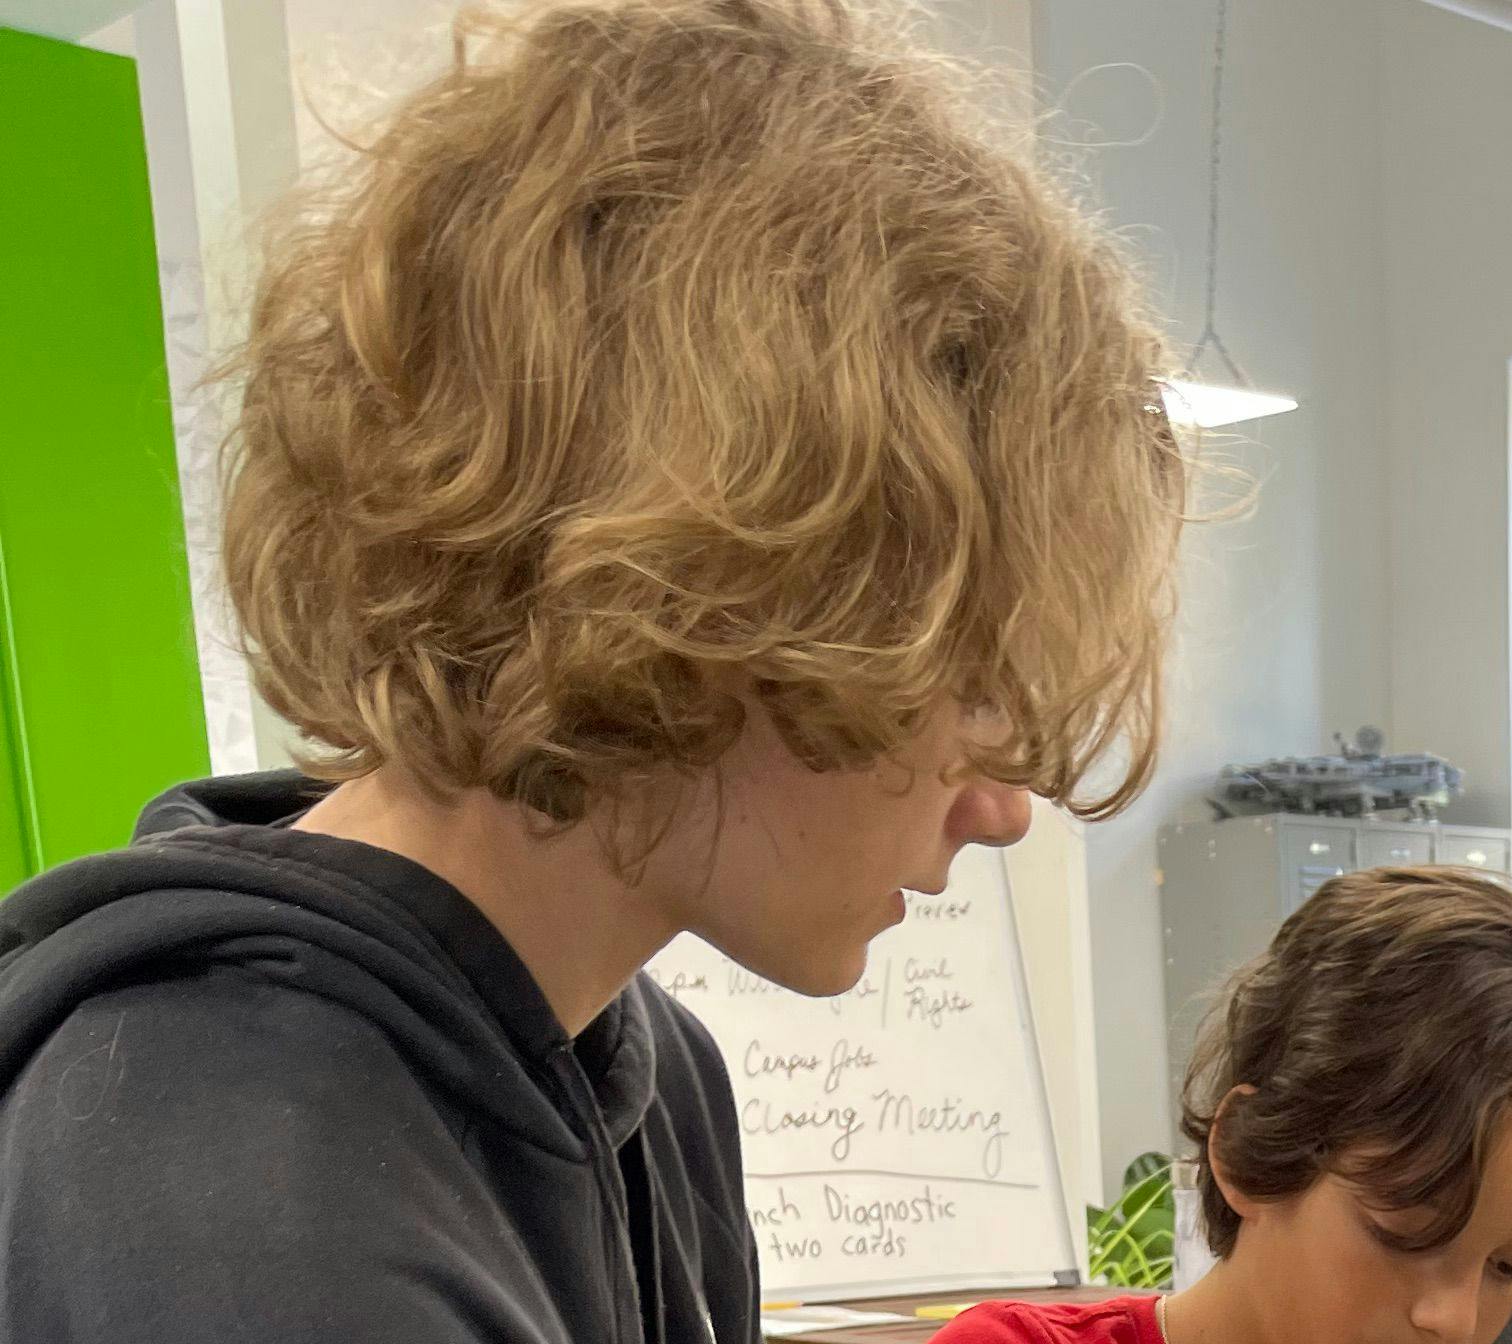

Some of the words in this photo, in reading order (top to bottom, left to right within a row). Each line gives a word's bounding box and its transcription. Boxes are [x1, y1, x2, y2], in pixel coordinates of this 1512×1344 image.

[743, 1039, 822, 1079] Campus
[824, 1039, 879, 1094] Jobs
[741, 1098, 865, 1161] Closing
[872, 1089, 1010, 1179] Meeting
[823, 1183, 957, 1238] Diagnostic
[768, 1232, 822, 1262] two
[841, 1227, 906, 1257] cards
